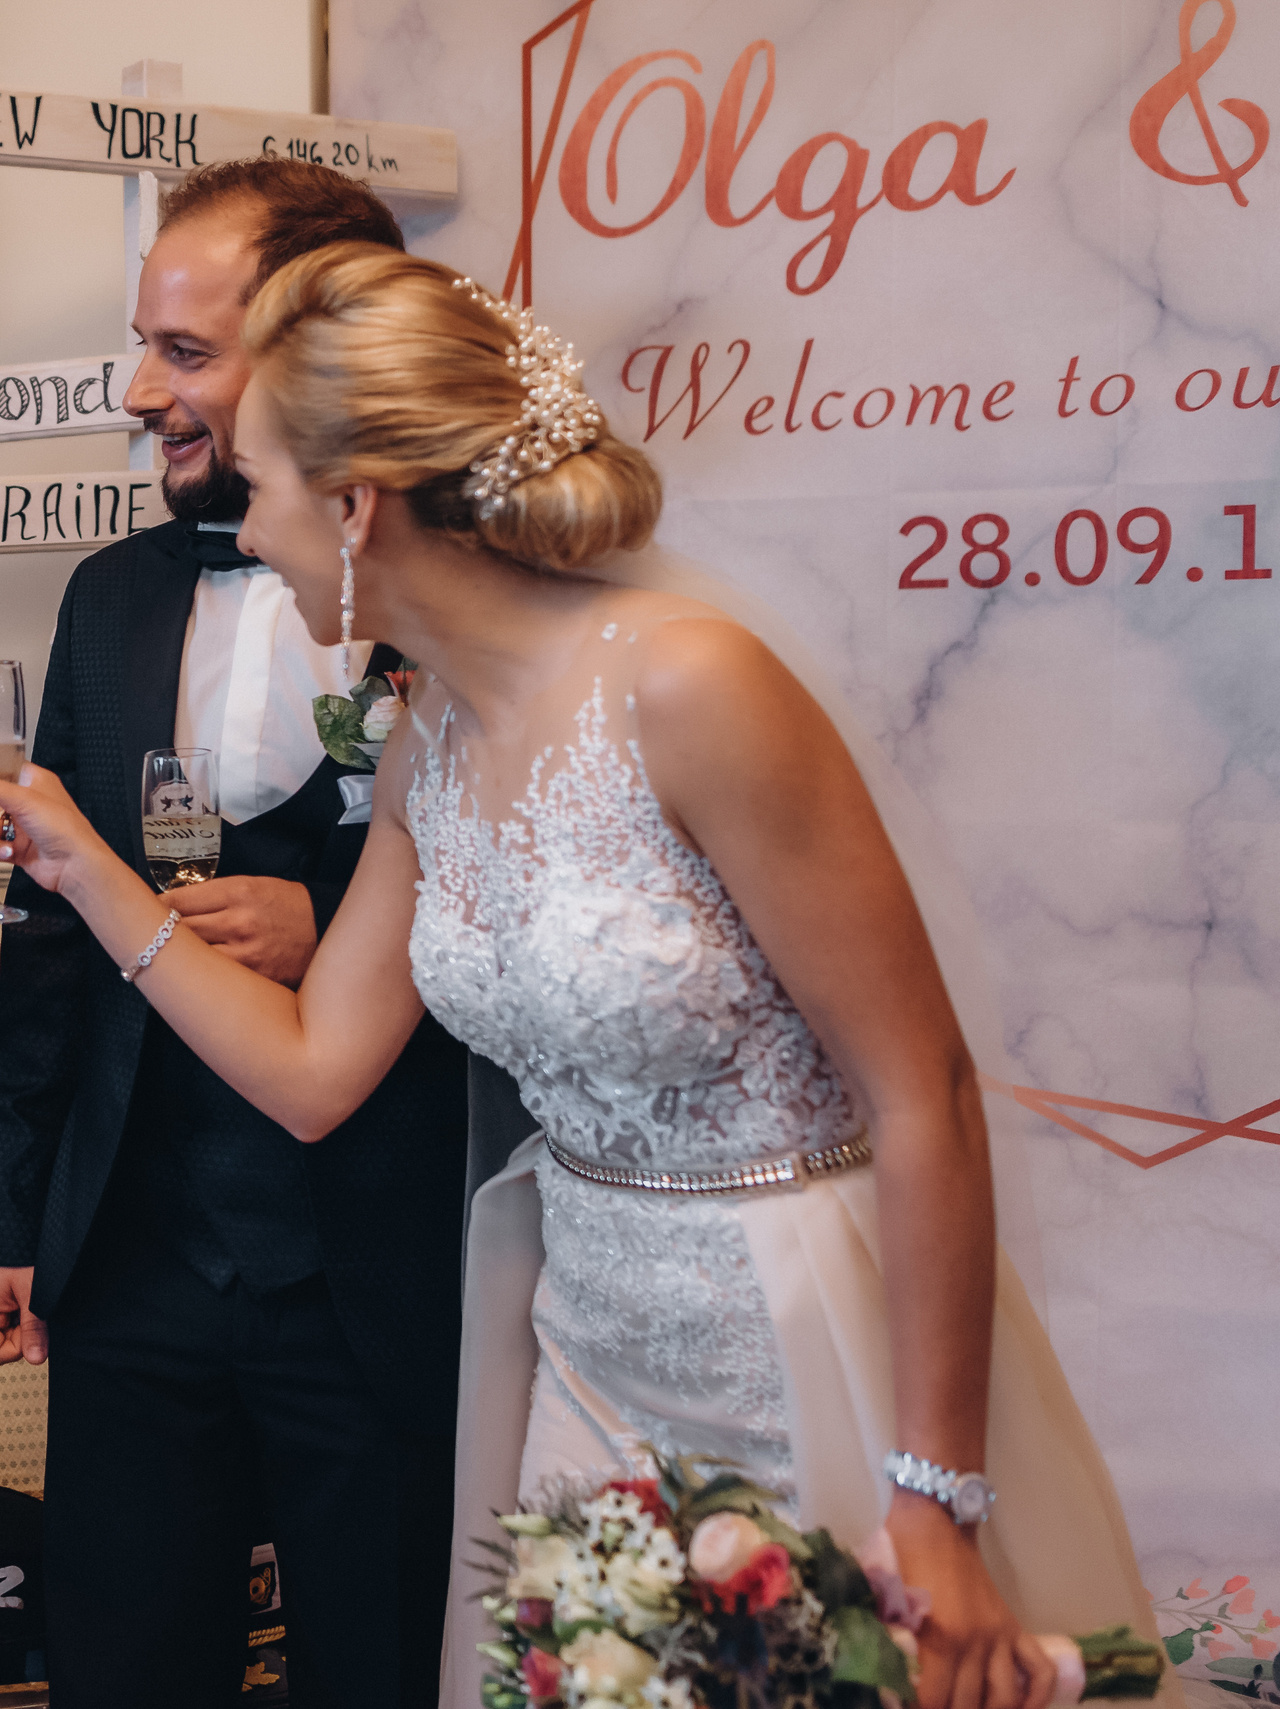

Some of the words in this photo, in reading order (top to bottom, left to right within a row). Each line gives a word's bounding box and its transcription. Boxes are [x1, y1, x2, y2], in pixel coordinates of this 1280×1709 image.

[91, 101, 206, 168] YORK
[365, 133, 400, 172] km
[558, 39, 1017, 296] Olga
[1129, 0, 1270, 207] &
[620, 337, 1017, 444] Welcome
[1056, 355, 1136, 420] to
[1174, 363, 1280, 413] ou
[897, 503, 1276, 592] 28.09.1
